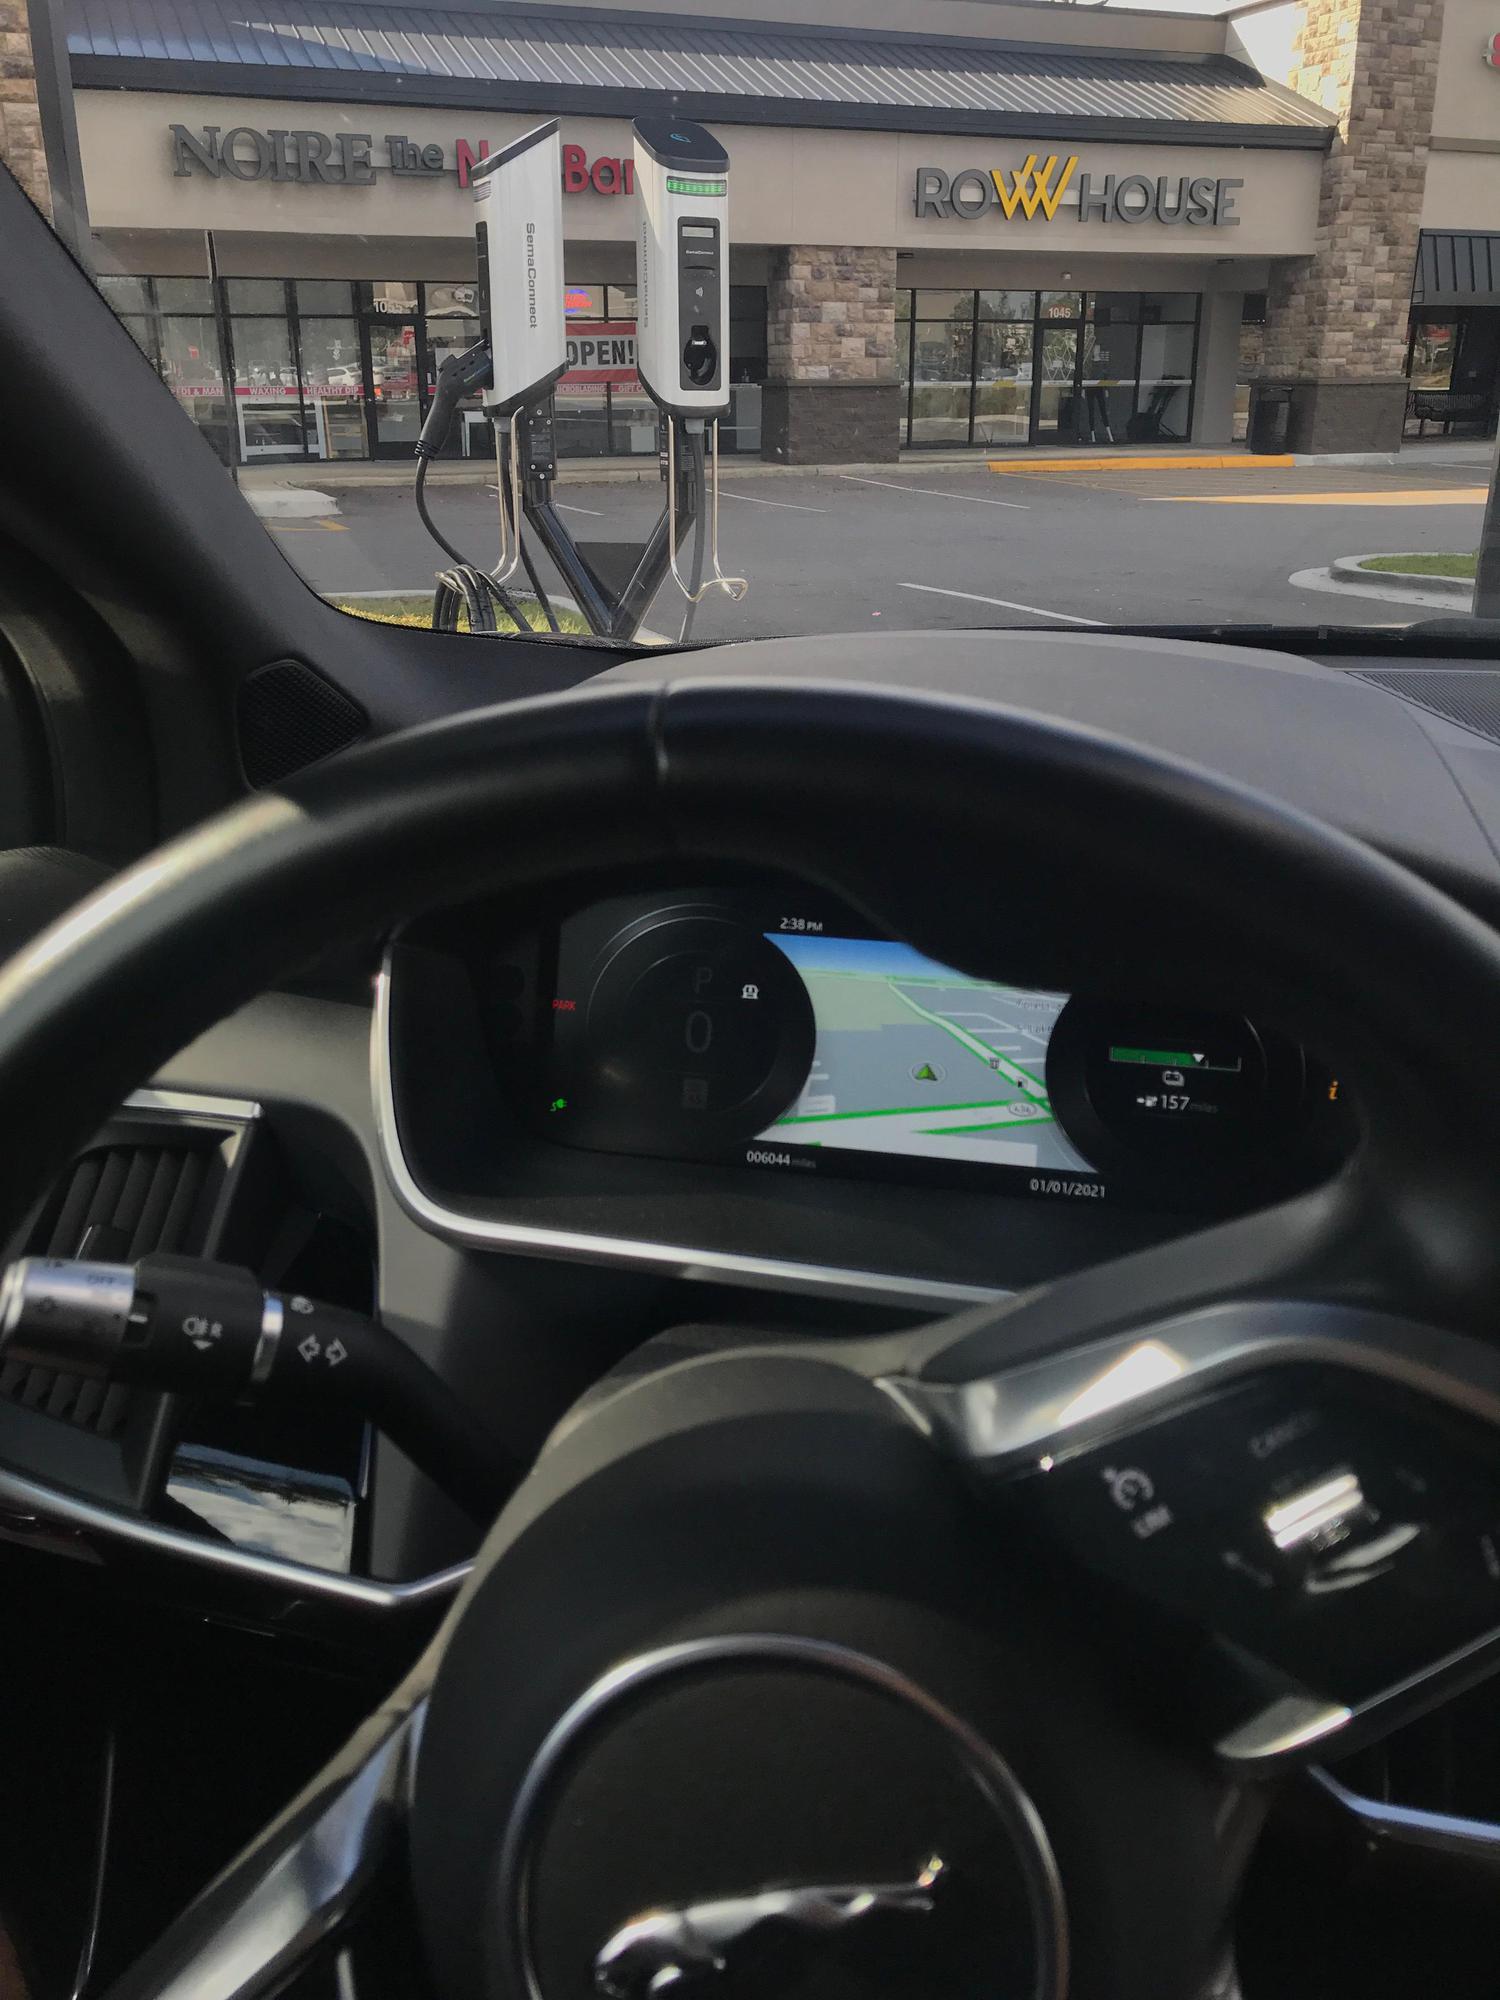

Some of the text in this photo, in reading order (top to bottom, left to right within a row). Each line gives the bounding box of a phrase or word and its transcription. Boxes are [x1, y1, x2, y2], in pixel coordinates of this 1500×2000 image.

[168, 124, 376, 185] NOIRE
[385, 135, 445, 175] The
[1078, 173, 1244, 226] HOUSE
[526, 222, 538, 329] SemaConnect
[1049, 307, 1071, 319] 1045
[566, 340, 635, 366] OPEN!
[250, 386, 286, 396] WAXING
[306, 386, 359, 396] HEALTHY DIP
[780, 917, 823, 931] 2:38 PM
[552, 999, 577, 1011] PARK
[1160, 1094, 1190, 1111] 157
[746, 1149, 791, 1167] 006044
[1029, 1178, 1105, 1198] 01/01/2021
